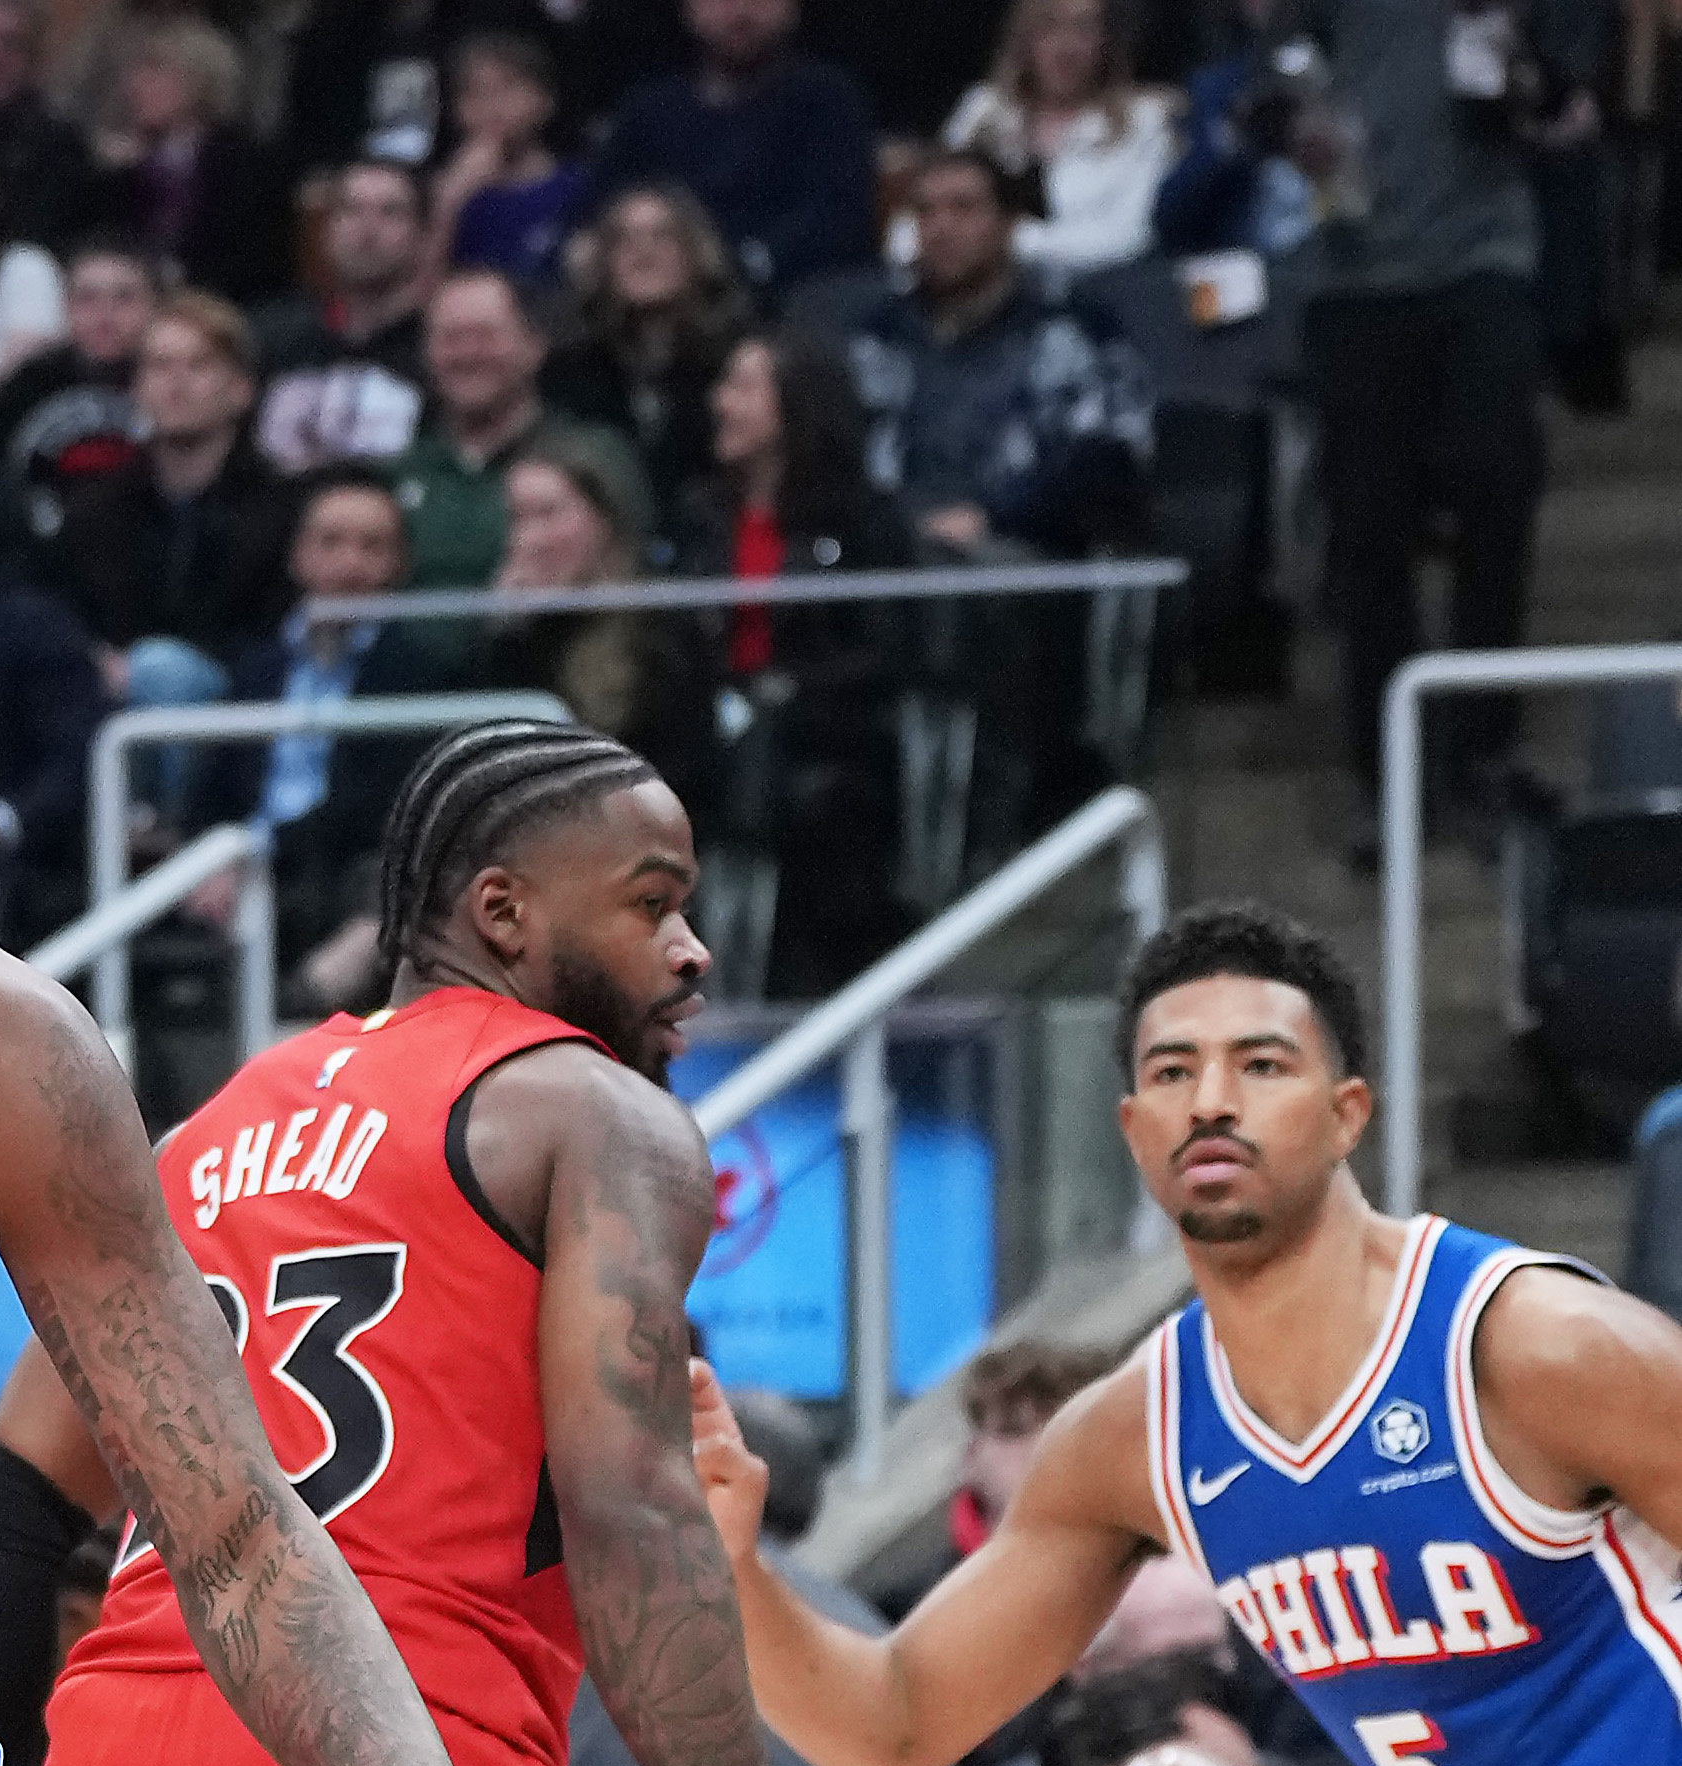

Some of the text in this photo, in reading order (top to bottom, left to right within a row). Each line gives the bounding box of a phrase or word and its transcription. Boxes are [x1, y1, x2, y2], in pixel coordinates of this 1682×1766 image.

[189, 1103, 388, 1229] SHEAD
[110, 1243, 407, 1576] 3
[1216, 1542, 1540, 1681] PHILA
